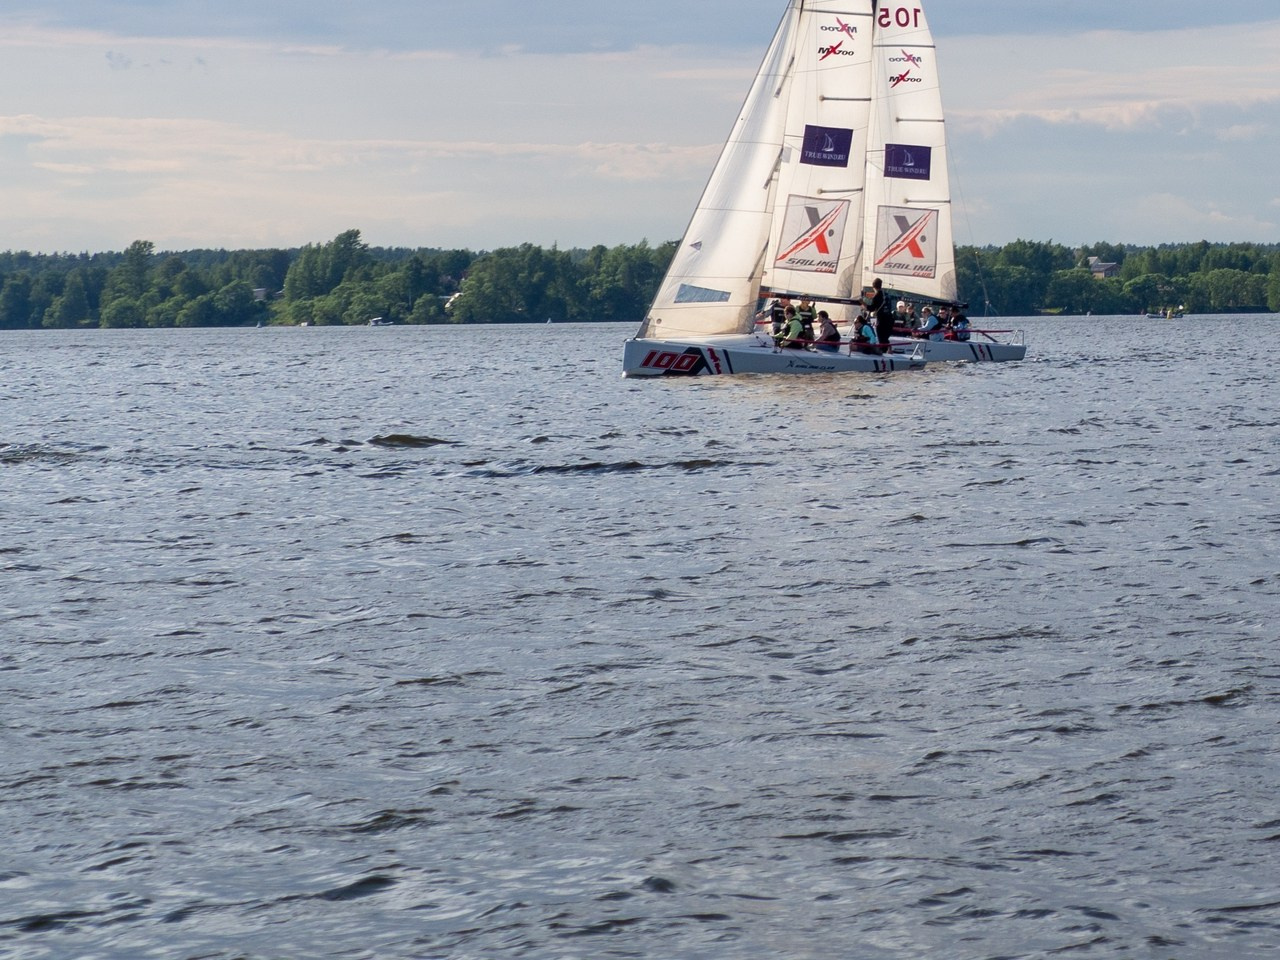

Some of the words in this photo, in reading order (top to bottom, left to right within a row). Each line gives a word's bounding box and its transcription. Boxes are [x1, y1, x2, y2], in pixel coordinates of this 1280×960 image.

[818, 40, 855, 61] MX700
[888, 69, 922, 88] MX700
[804, 151, 822, 159] TRUE
[887, 165, 904, 173] TRUE
[785, 257, 838, 269] SAILING
[883, 261, 934, 272] SAILING
[639, 349, 701, 372] 100
